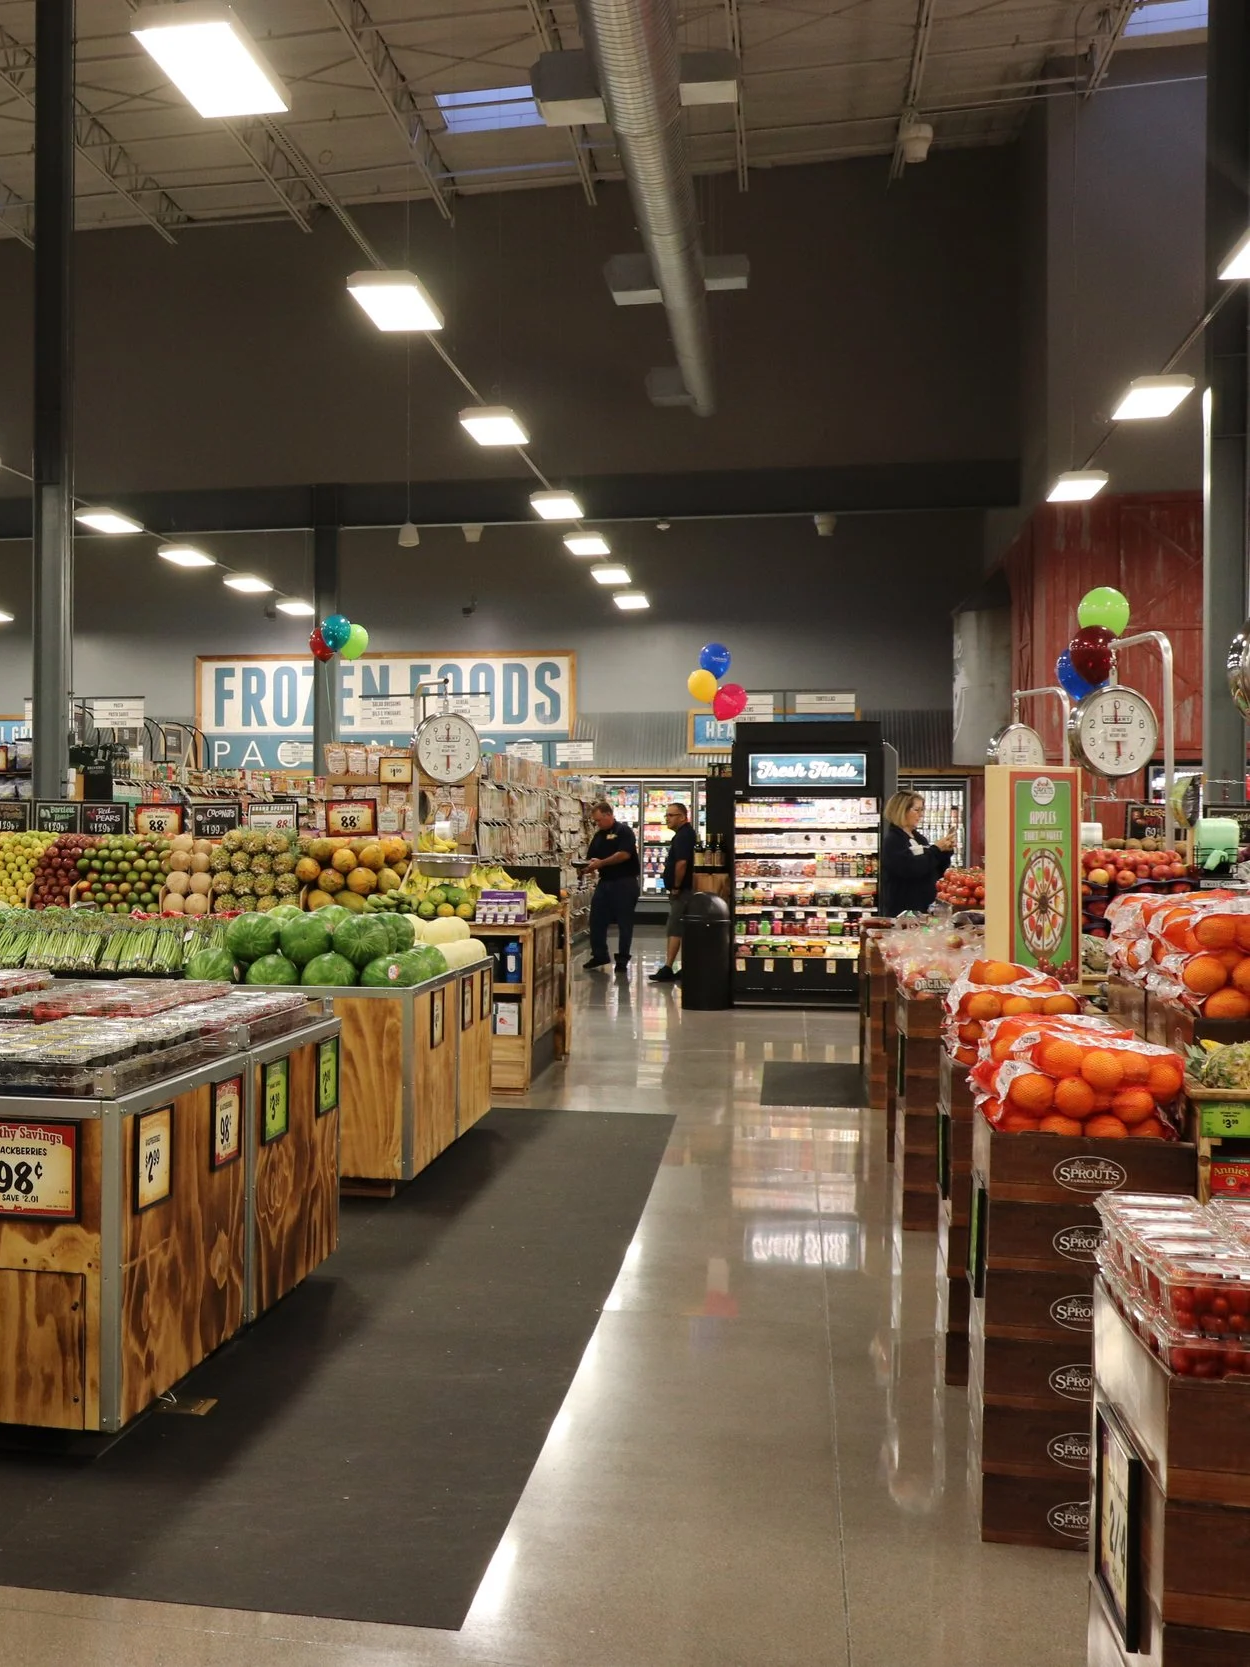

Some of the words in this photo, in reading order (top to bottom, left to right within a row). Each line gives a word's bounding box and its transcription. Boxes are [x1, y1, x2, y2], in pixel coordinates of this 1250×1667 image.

[757, 760, 807, 779] Fresh
[808, 760, 858, 779] Finds
[20, 1127, 62, 1145] Savings
[1059, 1167, 1120, 1182] SPROUTS
[1214, 1165, 1250, 1177] Annie's
[1056, 1306, 1093, 1320] SPRO
[1055, 1375, 1091, 1389] SPRO
[1054, 1444, 1090, 1457] SPRO
[1054, 1512, 1089, 1526] SPRO
